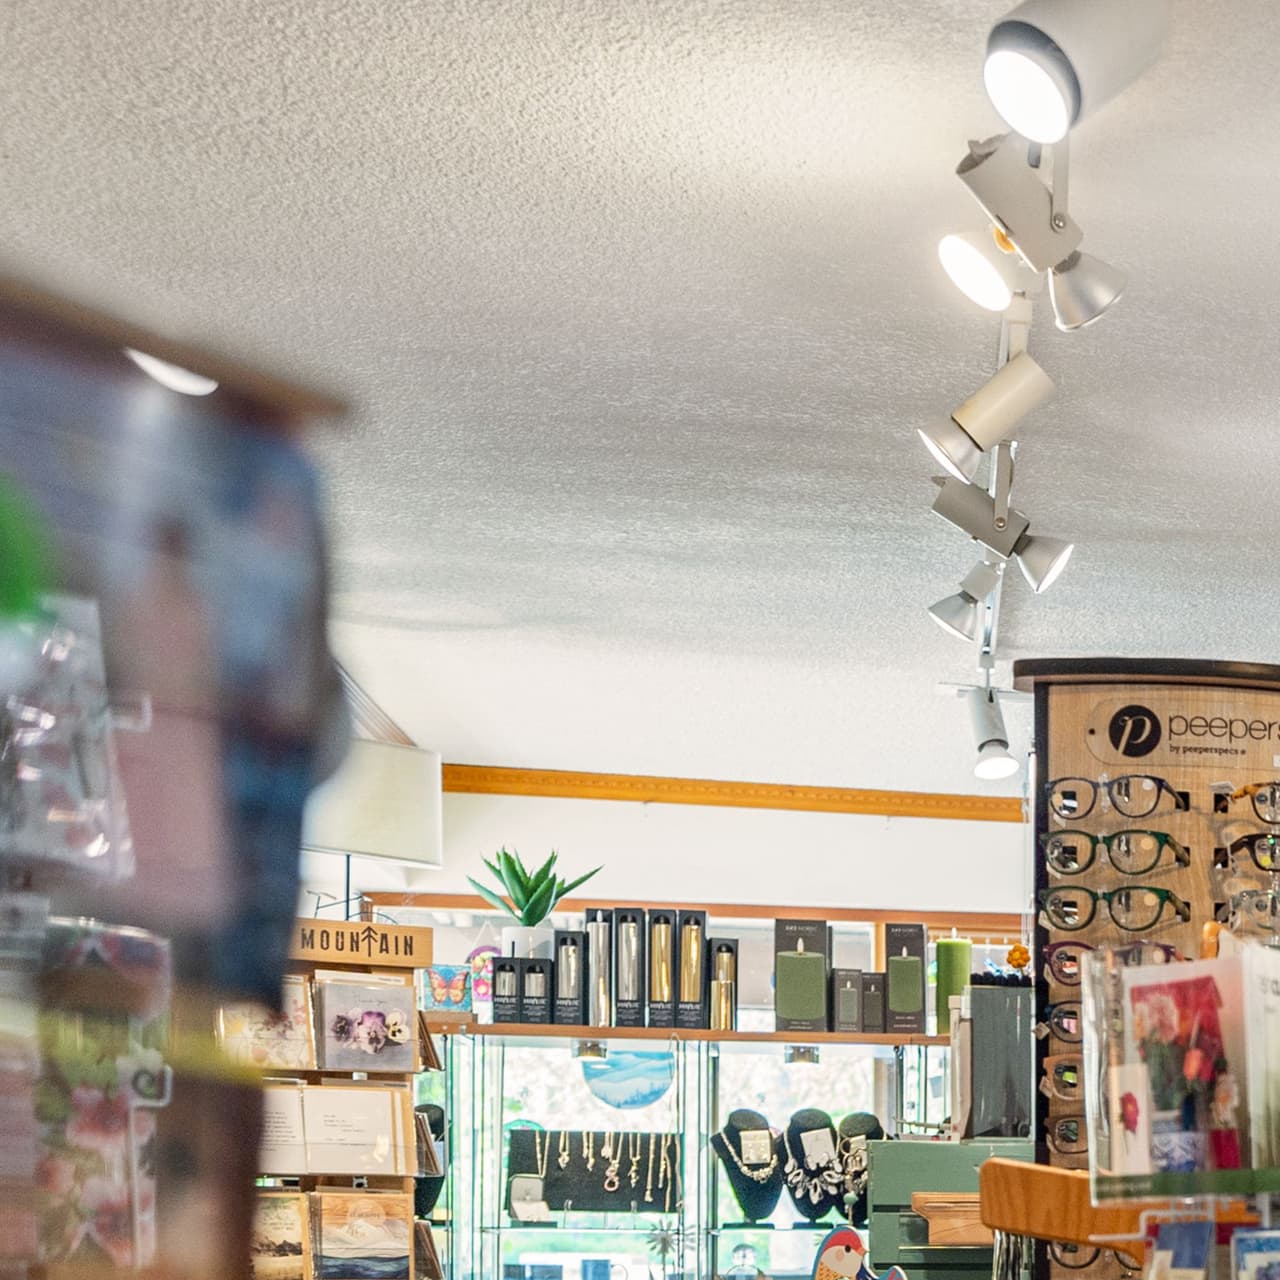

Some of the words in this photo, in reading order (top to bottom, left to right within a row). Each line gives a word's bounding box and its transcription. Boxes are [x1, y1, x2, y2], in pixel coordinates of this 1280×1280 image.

[1169, 744, 1181, 754] by
[1182, 745, 1239, 756] peeperspecs
[300, 926, 414, 957] MOUNTAIN
